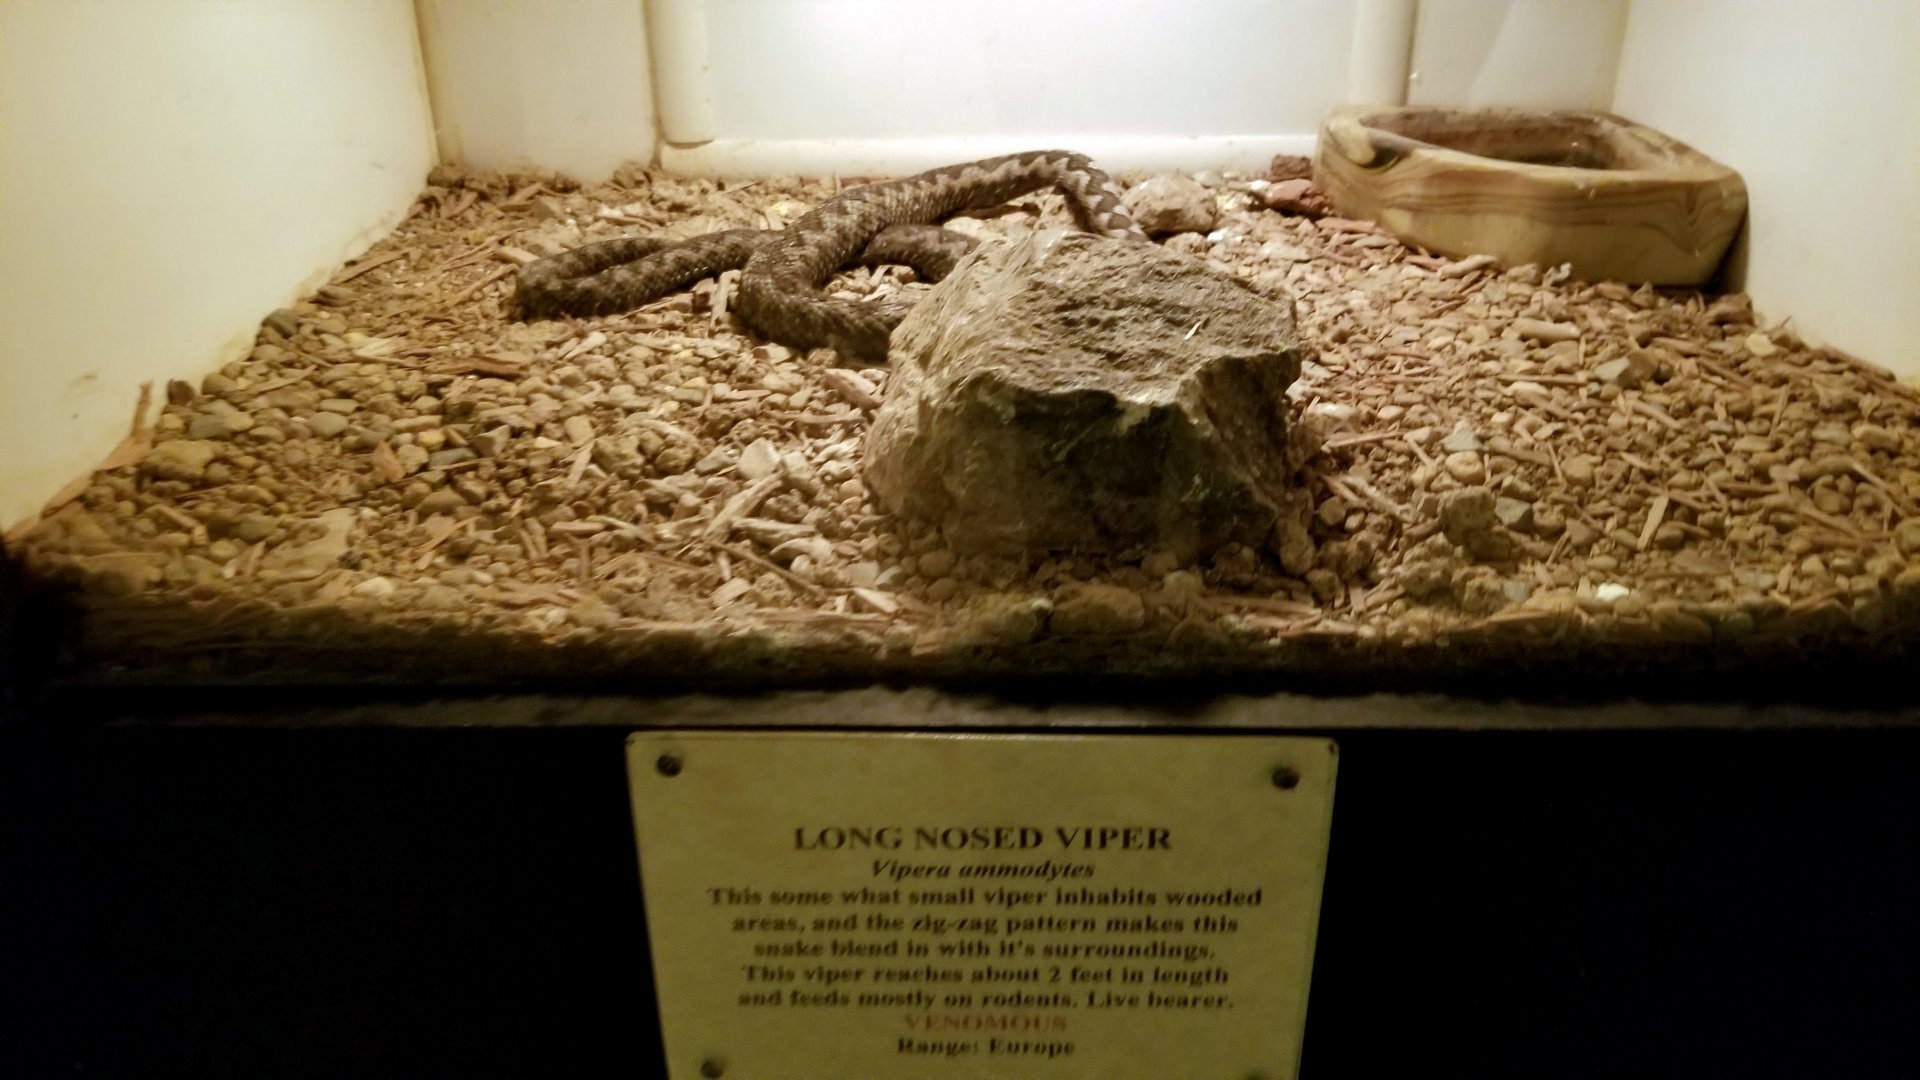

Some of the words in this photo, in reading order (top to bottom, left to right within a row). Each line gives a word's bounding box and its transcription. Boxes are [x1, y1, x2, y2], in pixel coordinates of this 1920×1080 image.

[795, 826, 902, 850] LONG
[915, 826, 1044, 850] NOSED
[1056, 826, 1172, 850] VIPER
[873, 858, 950, 881] Vipera
[959, 860, 1095, 882] ammodytes
[708, 887, 763, 905] This
[769, 891, 833, 905] some
[840, 887, 900, 905] what
[908, 887, 974, 905] small
[984, 888, 1047, 908] viper
[1056, 887, 1157, 906] inhabits
[1165, 888, 1262, 906] wooded
[732, 917, 805, 933] areas,
[811, 914, 857, 931] and
[866, 913, 904, 931] the
[911, 913, 998, 934] zig-zag
[1007, 916, 1096, 935] pattern
[1106, 915, 1184, 932] makes
[1193, 914, 1238, 933] this
[754, 939, 823, 957] snake
[832, 939, 898, 957] blend
[907, 940, 929, 957] in
[939, 940, 990, 957] with
[1000, 939, 1034, 957] it's
[1043, 940, 1215, 962] surroundings.
[742, 965, 796, 982] This
[805, 966, 865, 986] viper
[873, 965, 963, 983] reaches
[971, 965, 1038, 983] about
[1049, 966, 1061, 983] 2
[1071, 966, 1112, 983] feet
[1122, 966, 1144, 983] in
[1153, 966, 1228, 987] length
[738, 990, 782, 1007] and
[790, 989, 850, 1007] feeds
[858, 990, 935, 1009] mostly
[944, 994, 972, 1007] on
[982, 990, 1078, 1009] rodents.
[1087, 990, 1140, 1009] Live
[1149, 991, 1234, 1010] bearer.
[903, 1014, 1067, 1031] VENOMOUS
[898, 1037, 979, 1056] Range:
[990, 1038, 1074, 1058] Europe
